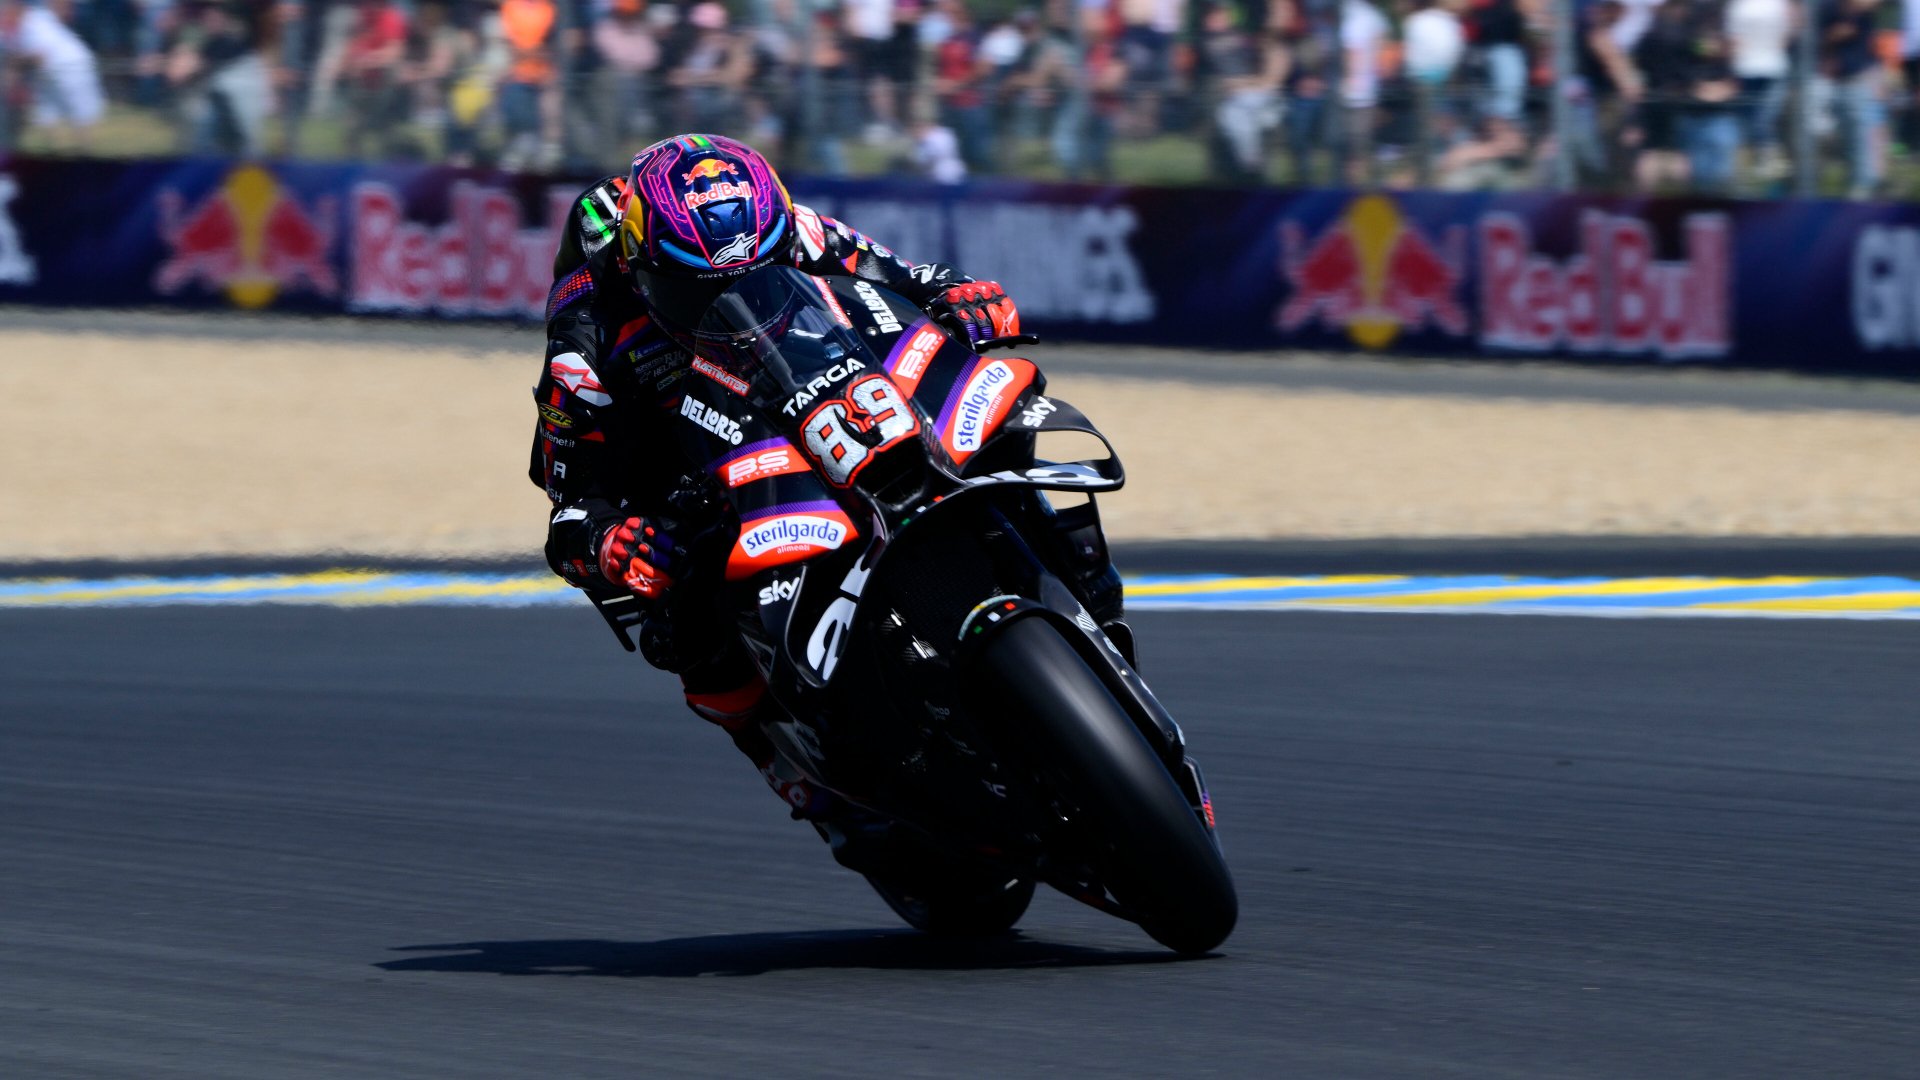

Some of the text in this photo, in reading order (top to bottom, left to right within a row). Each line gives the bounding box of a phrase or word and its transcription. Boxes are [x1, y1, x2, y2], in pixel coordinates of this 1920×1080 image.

[684, 181, 752, 209] Red Bull
[350, 179, 582, 318] Red Bu
[1479, 211, 1732, 358] Red Bull
[895, 330, 938, 379] BS
[782, 357, 866, 417] TARGA
[960, 366, 1007, 446] sterilgarda
[985, 395, 1003, 424] alimenti
[1022, 395, 1057, 428] sky
[802, 375, 917, 487] 89
[728, 450, 789, 482] BS
[746, 520, 839, 549] sterilgarda
[777, 544, 810, 554] alimenti
[758, 577, 800, 605] sky
